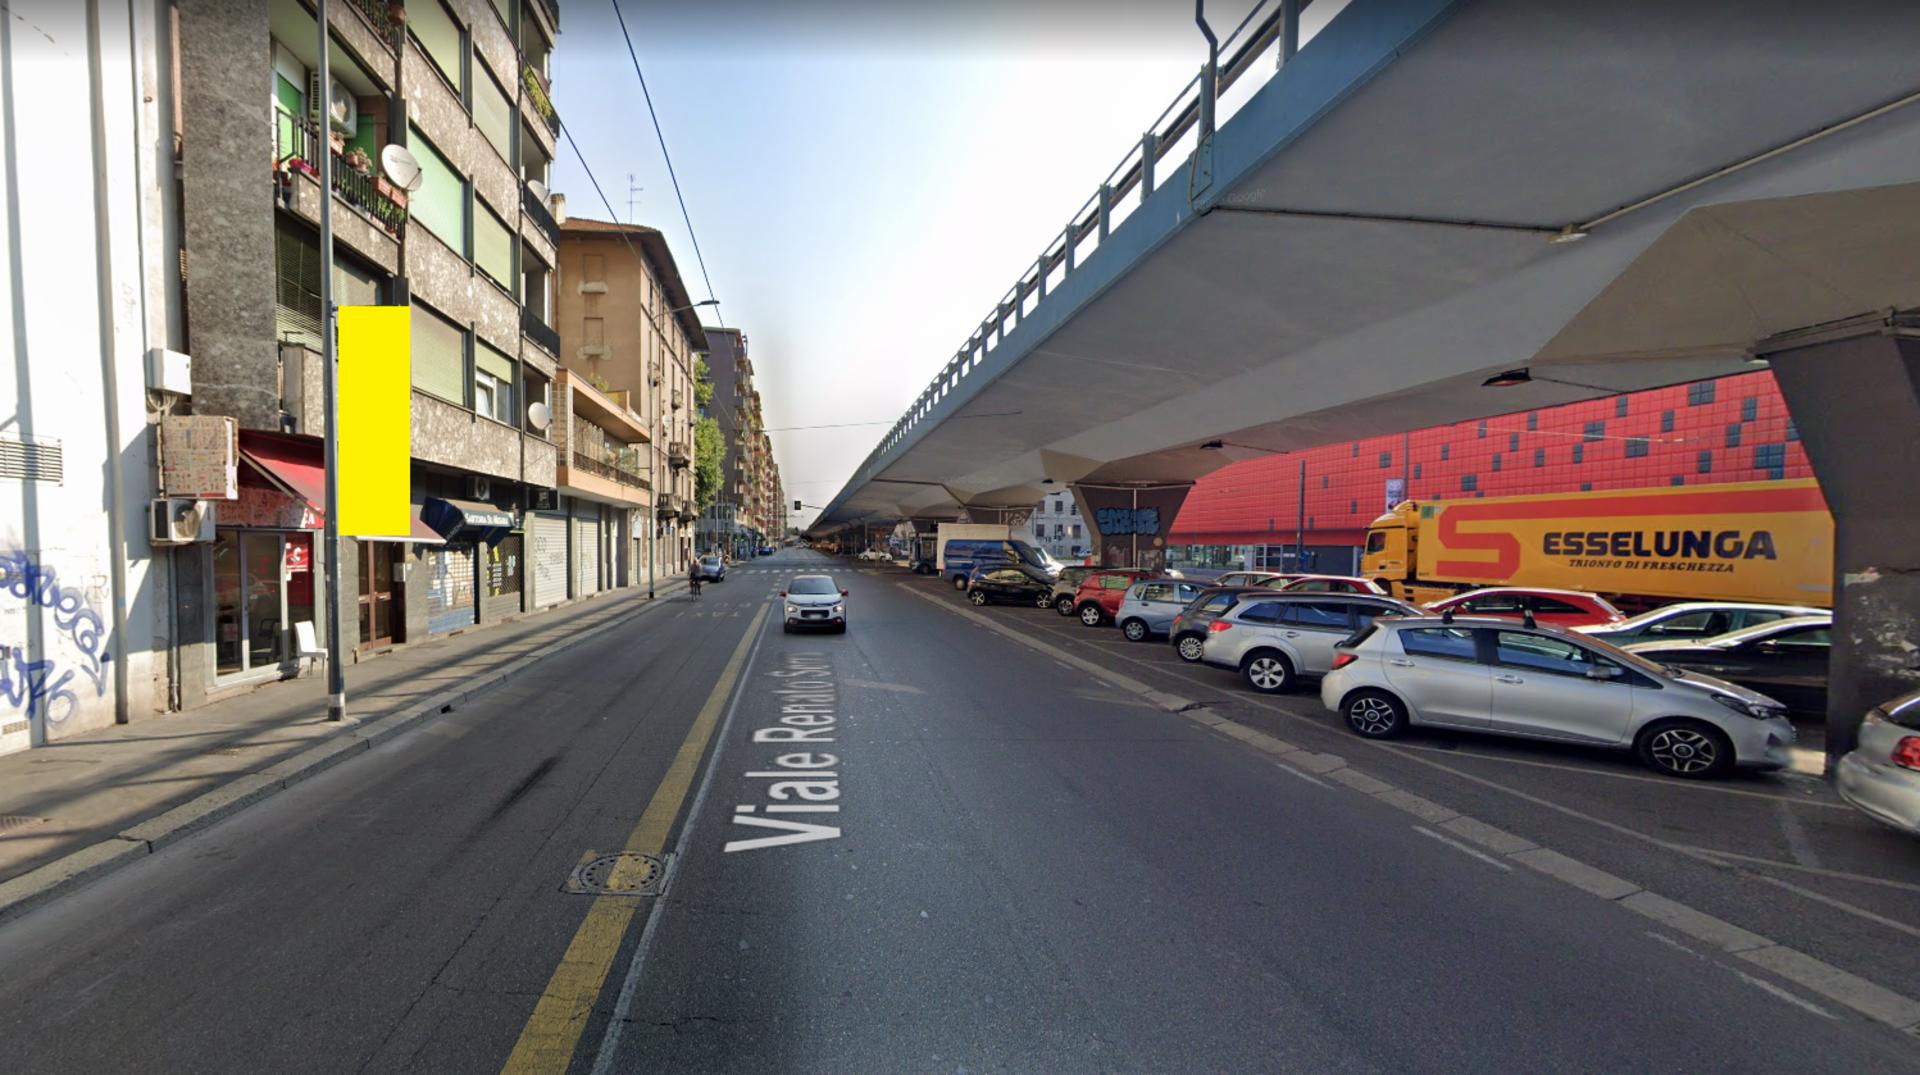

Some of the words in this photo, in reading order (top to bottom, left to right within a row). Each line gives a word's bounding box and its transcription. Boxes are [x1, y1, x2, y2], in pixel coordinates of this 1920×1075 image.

[1543, 530, 1777, 560] ESSELUNGA
[1569, 558, 1621, 569] TRIONFO
[1625, 560, 1639, 570] DI
[1642, 560, 1735, 573] FRESCHEZZA
